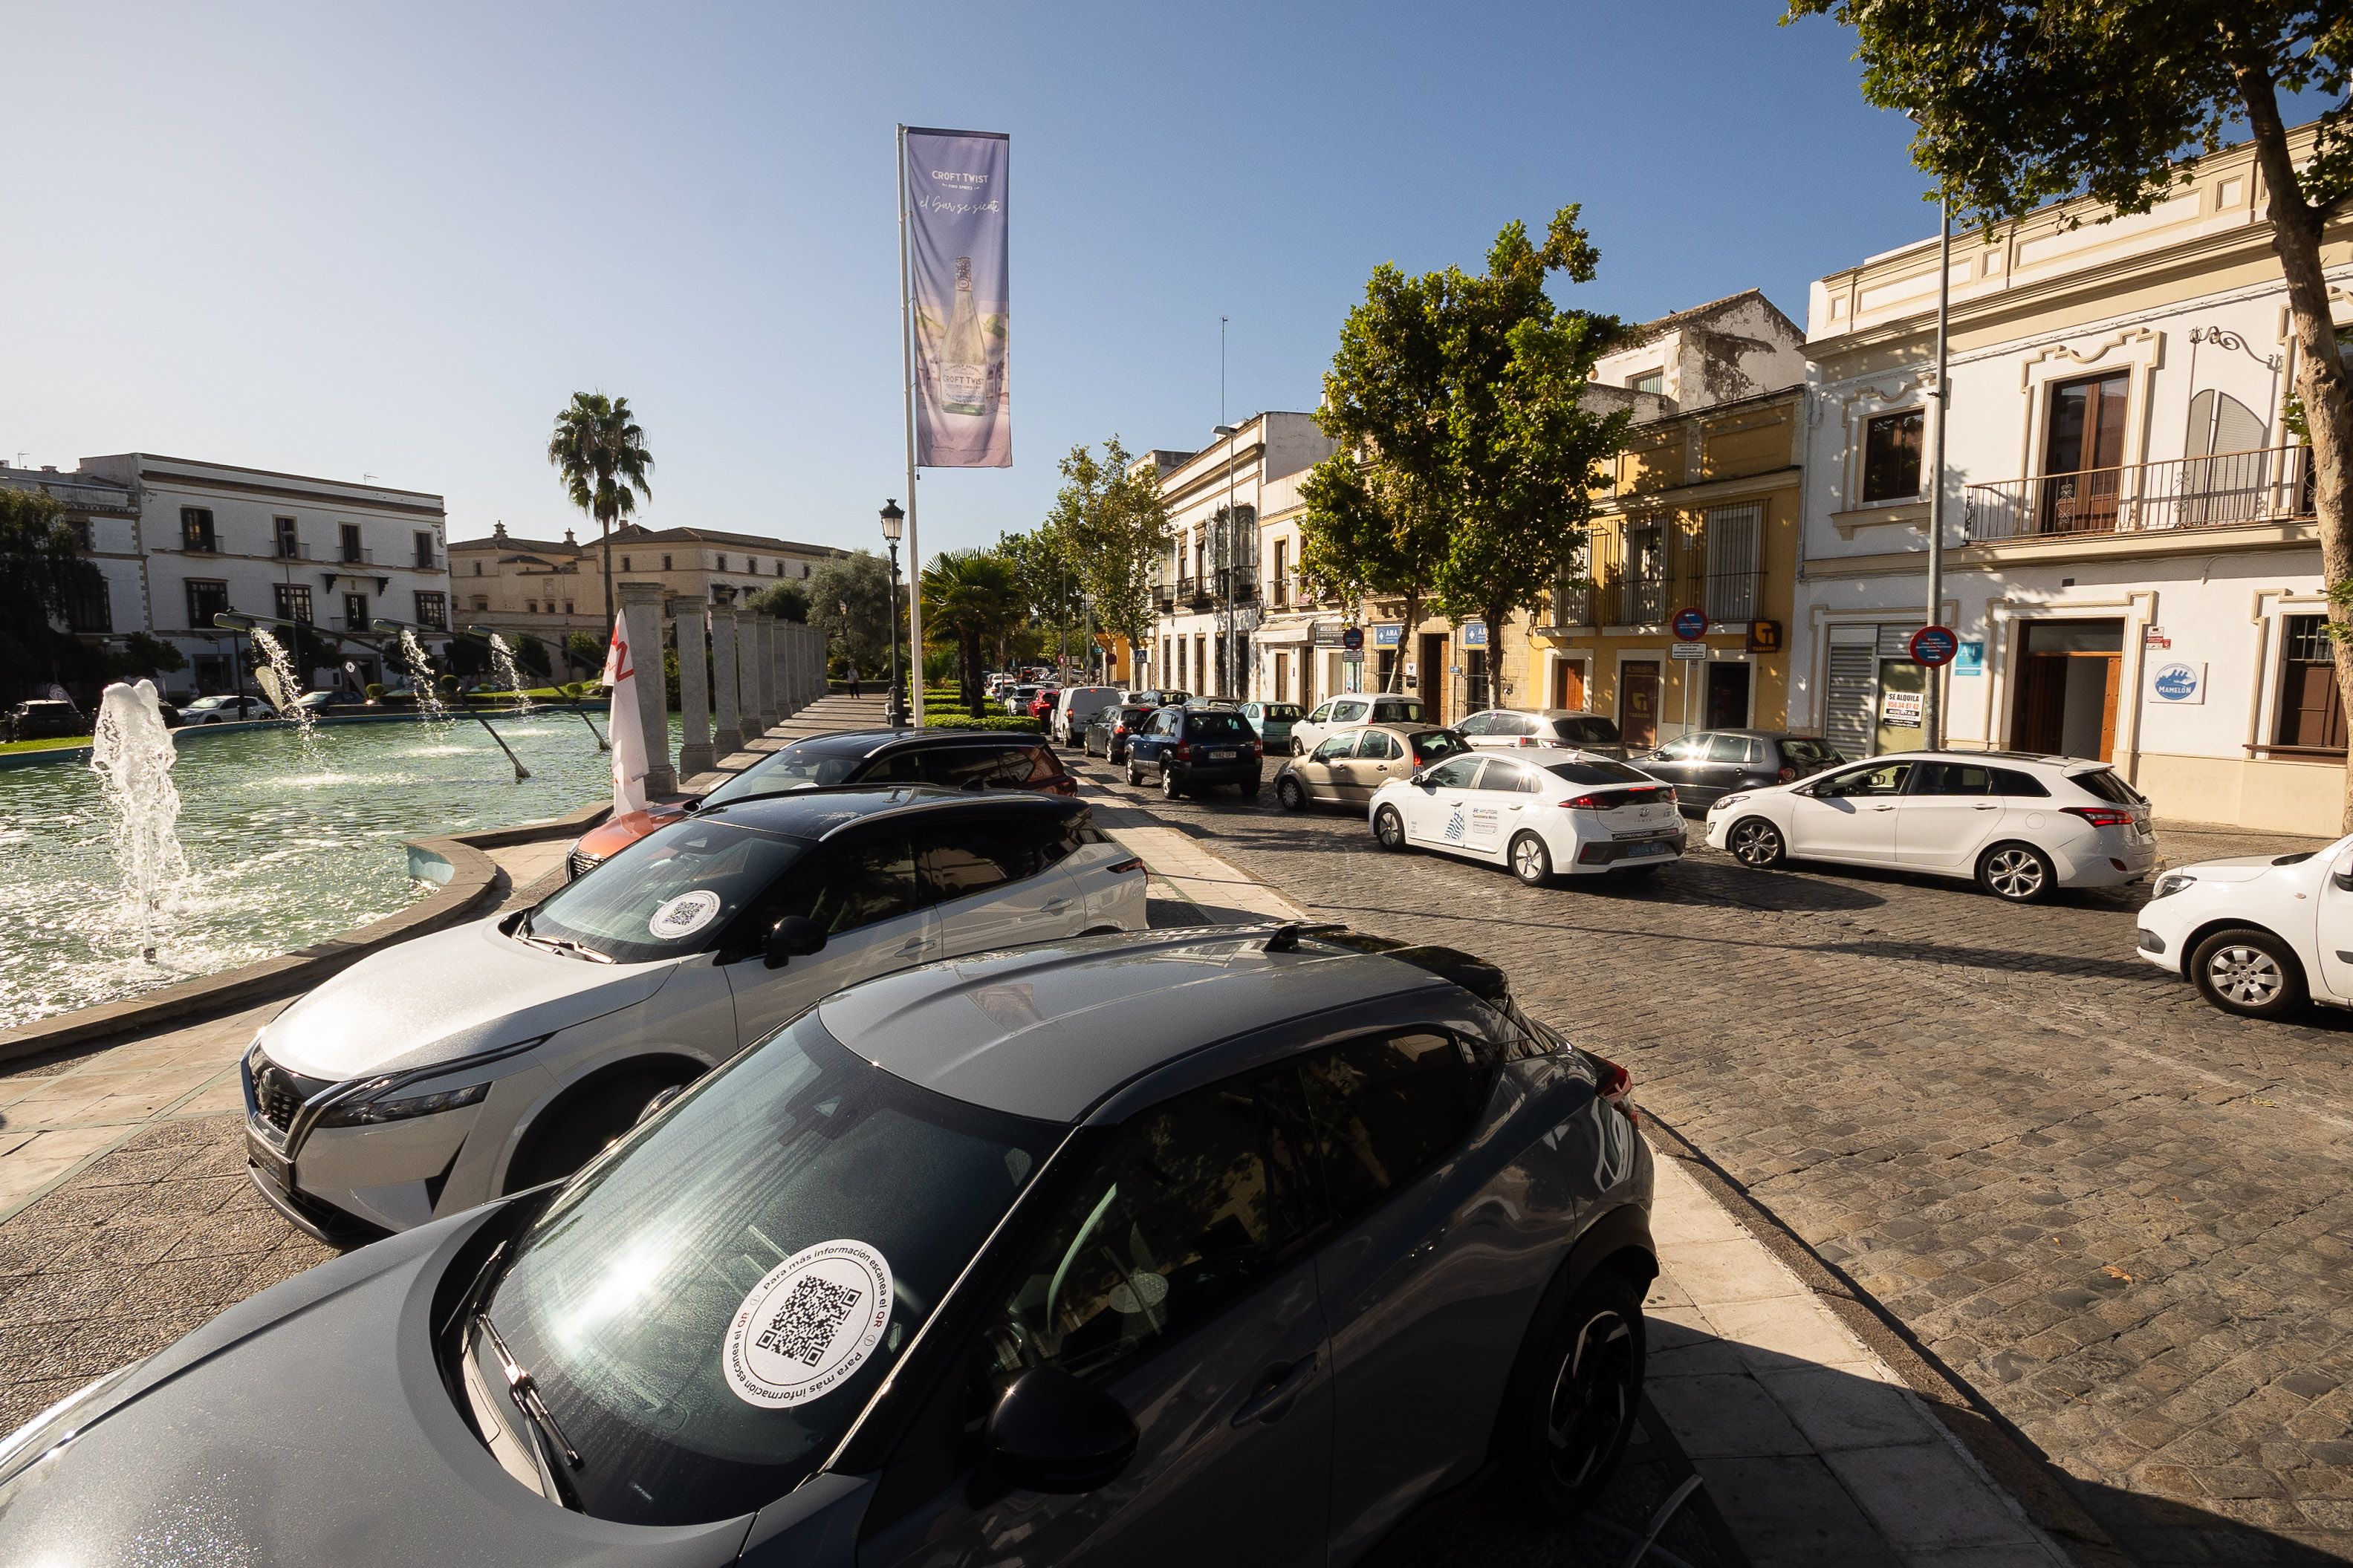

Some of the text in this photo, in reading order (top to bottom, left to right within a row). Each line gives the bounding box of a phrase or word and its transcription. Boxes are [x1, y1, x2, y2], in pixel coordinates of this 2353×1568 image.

[932, 170, 989, 183] CROFT TWIST
[943, 374, 984, 386] CROFT TWIST
[1959, 645, 1980, 657] AT
[1896, 694, 1919, 702] ALQUILA
[814, 1247, 871, 1262] información
[789, 1255, 811, 1269] más
[869, 1259, 886, 1296] escanea
[879, 1298, 887, 1308] el
[737, 1312, 750, 1328] QR
[873, 1311, 885, 1328] QR
[734, 1330, 741, 1340] el
[732, 1342, 747, 1382] escanea
[809, 1374, 835, 1392] más
[744, 1380, 806, 1401] información
